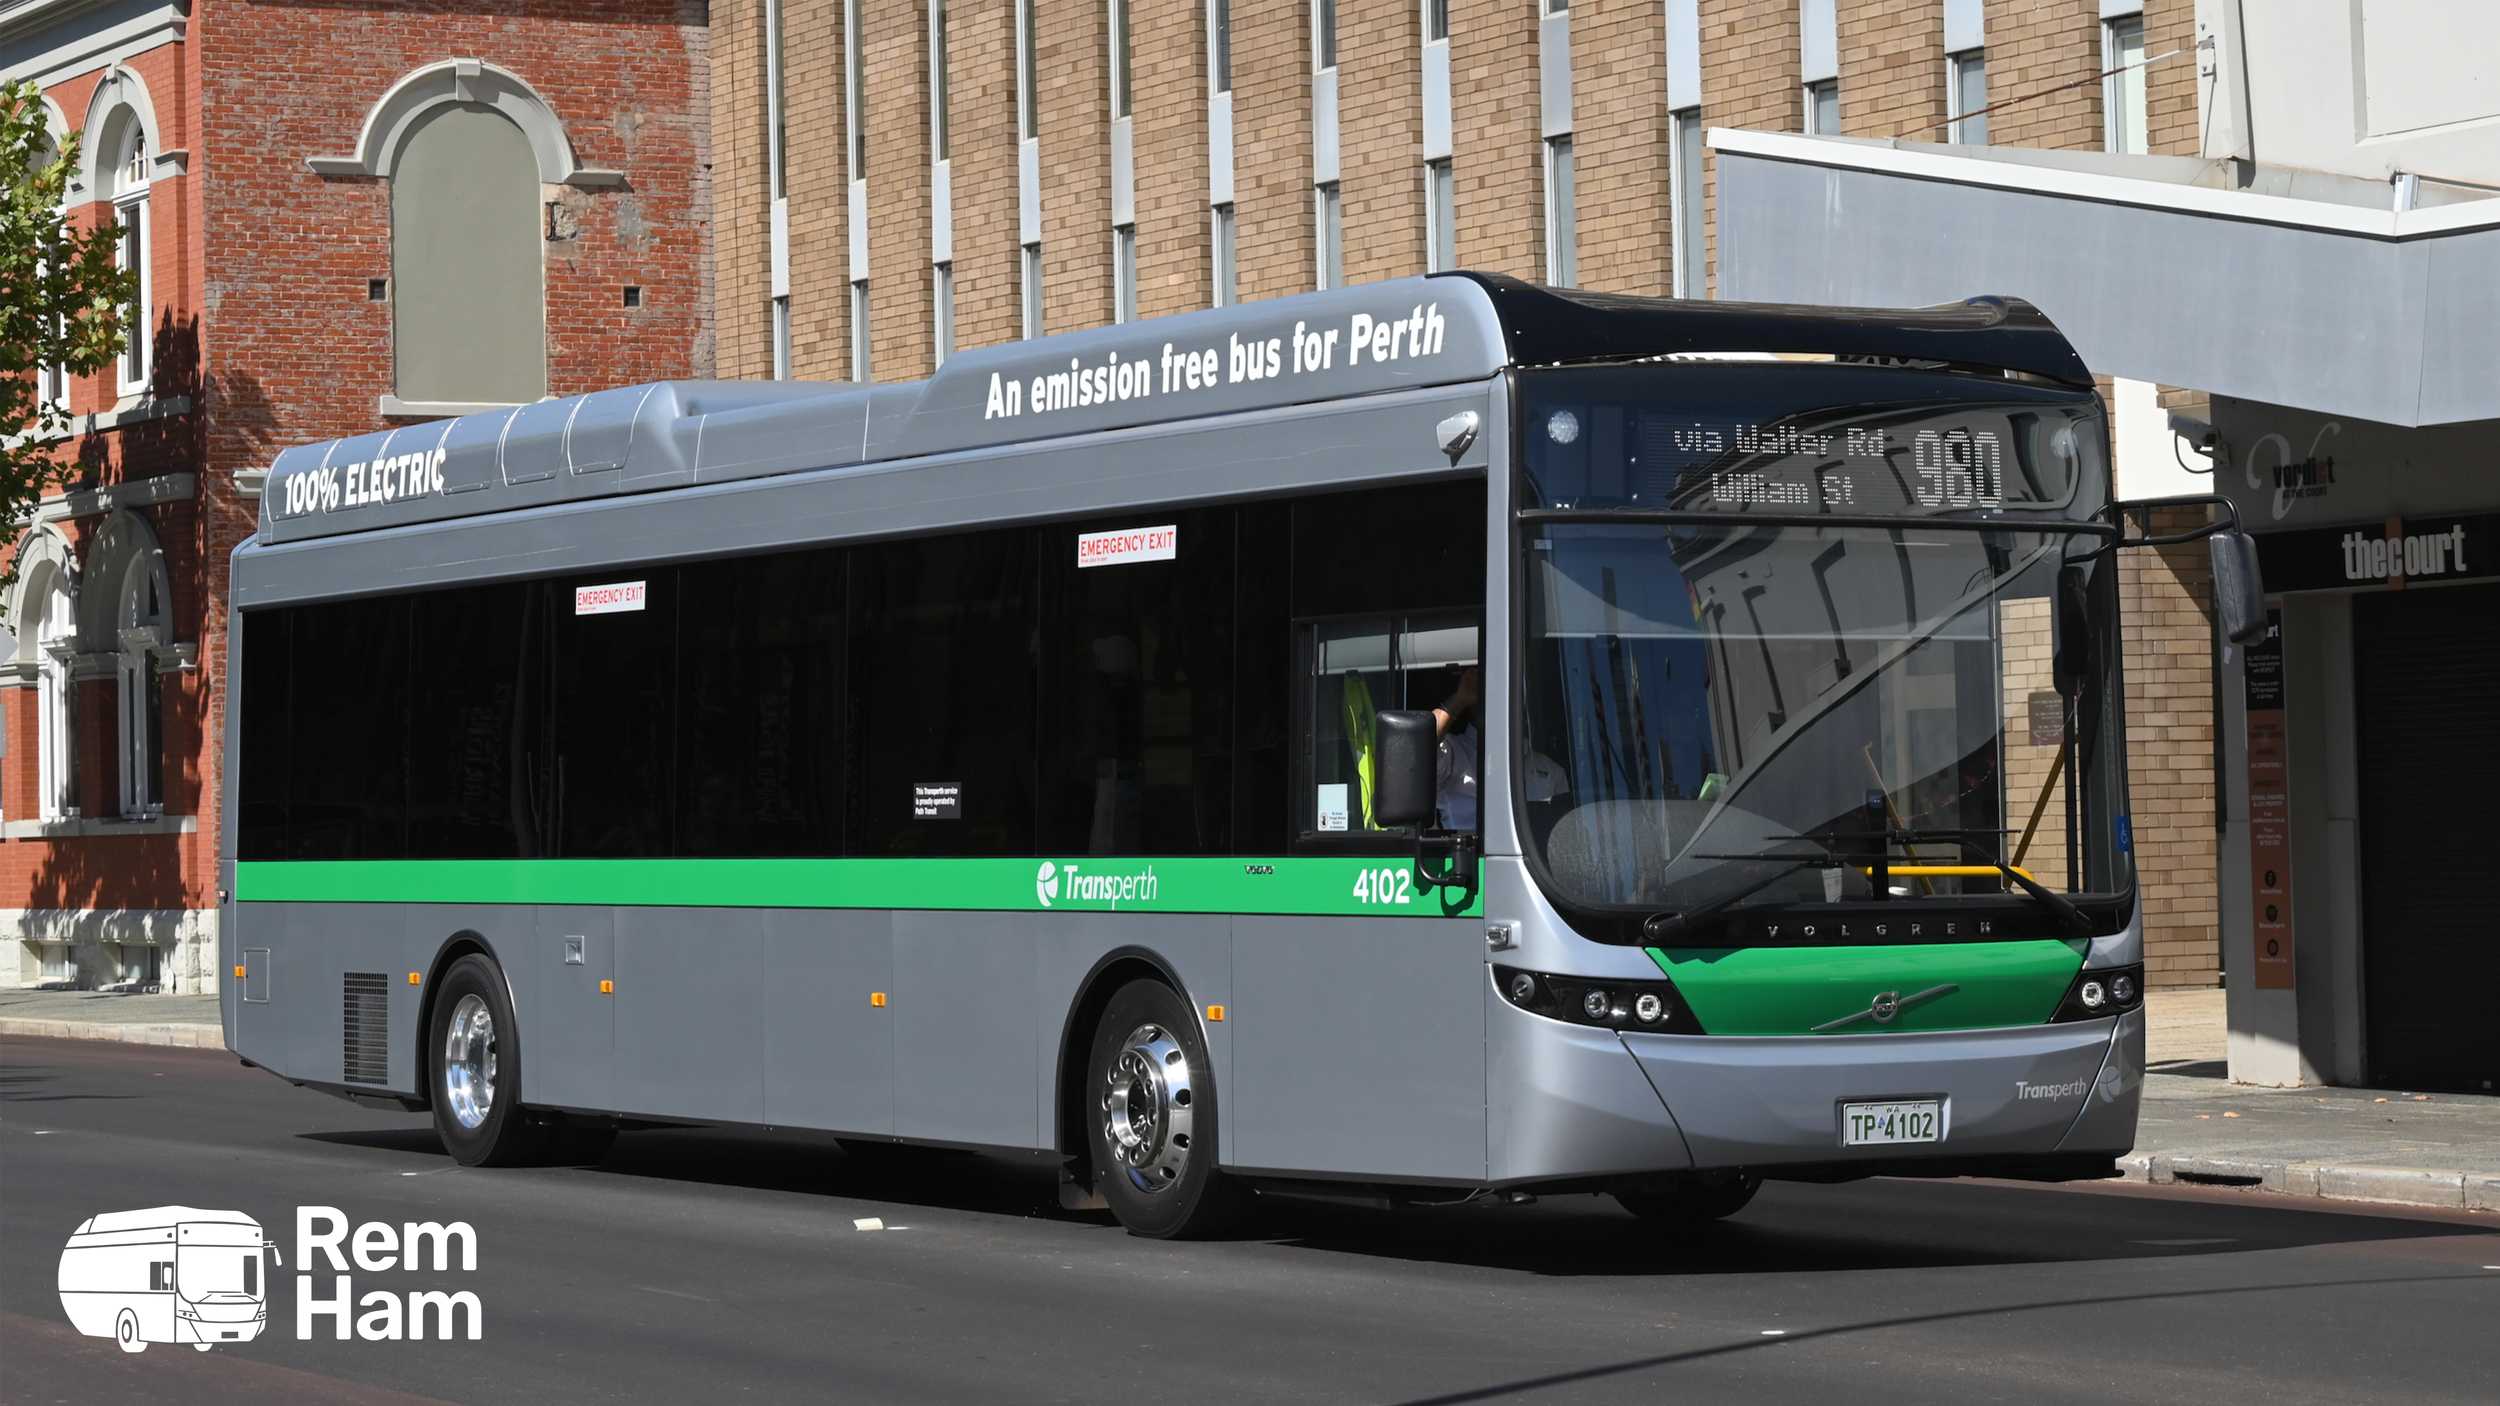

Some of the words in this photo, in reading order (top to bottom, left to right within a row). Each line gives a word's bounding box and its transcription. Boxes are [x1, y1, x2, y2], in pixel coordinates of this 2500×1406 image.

[984, 371, 1021, 420] An
[1030, 351, 1151, 413] emission
[1161, 343, 1219, 394] free
[1228, 332, 1281, 384] bus
[1292, 321, 1339, 374] for
[1349, 302, 1446, 366] Perth
[1674, 422, 1722, 452] via
[1735, 423, 1834, 455] Walter
[1847, 427, 1884, 457] Rd
[285, 466, 340, 515] 100%
[344, 447, 447, 507] ELECTRIC
[1915, 429, 2002, 509] 980
[2272, 456, 2335, 488] verdict
[1712, 472, 1809, 504] William
[1822, 475, 1854, 505] St
[2282, 489, 2289, 499] AT
[2291, 488, 2304, 498] THE
[2305, 486, 2327, 497] COURT
[1081, 534, 1146, 557] EMERGENCY
[1149, 531, 1174, 550] EXIT
[2341, 524, 2467, 580] thecourt
[577, 588, 624, 606] EMERGENCY
[626, 586, 644, 601] EXIT
[915, 787, 923, 795] This
[924, 787, 944, 796] Transperth
[944, 786, 958, 795] service
[1244, 865, 1275, 875] VOLVO
[1063, 865, 1157, 911] Transperth
[1352, 868, 1411, 904] 4102
[1767, 921, 1991, 938] VOLGREN
[2015, 1077, 2087, 1103] Transperth
[1885, 1104, 1900, 1113] WA
[1851, 1114, 1876, 1141] TP
[1884, 1112, 1933, 1139] 4102
